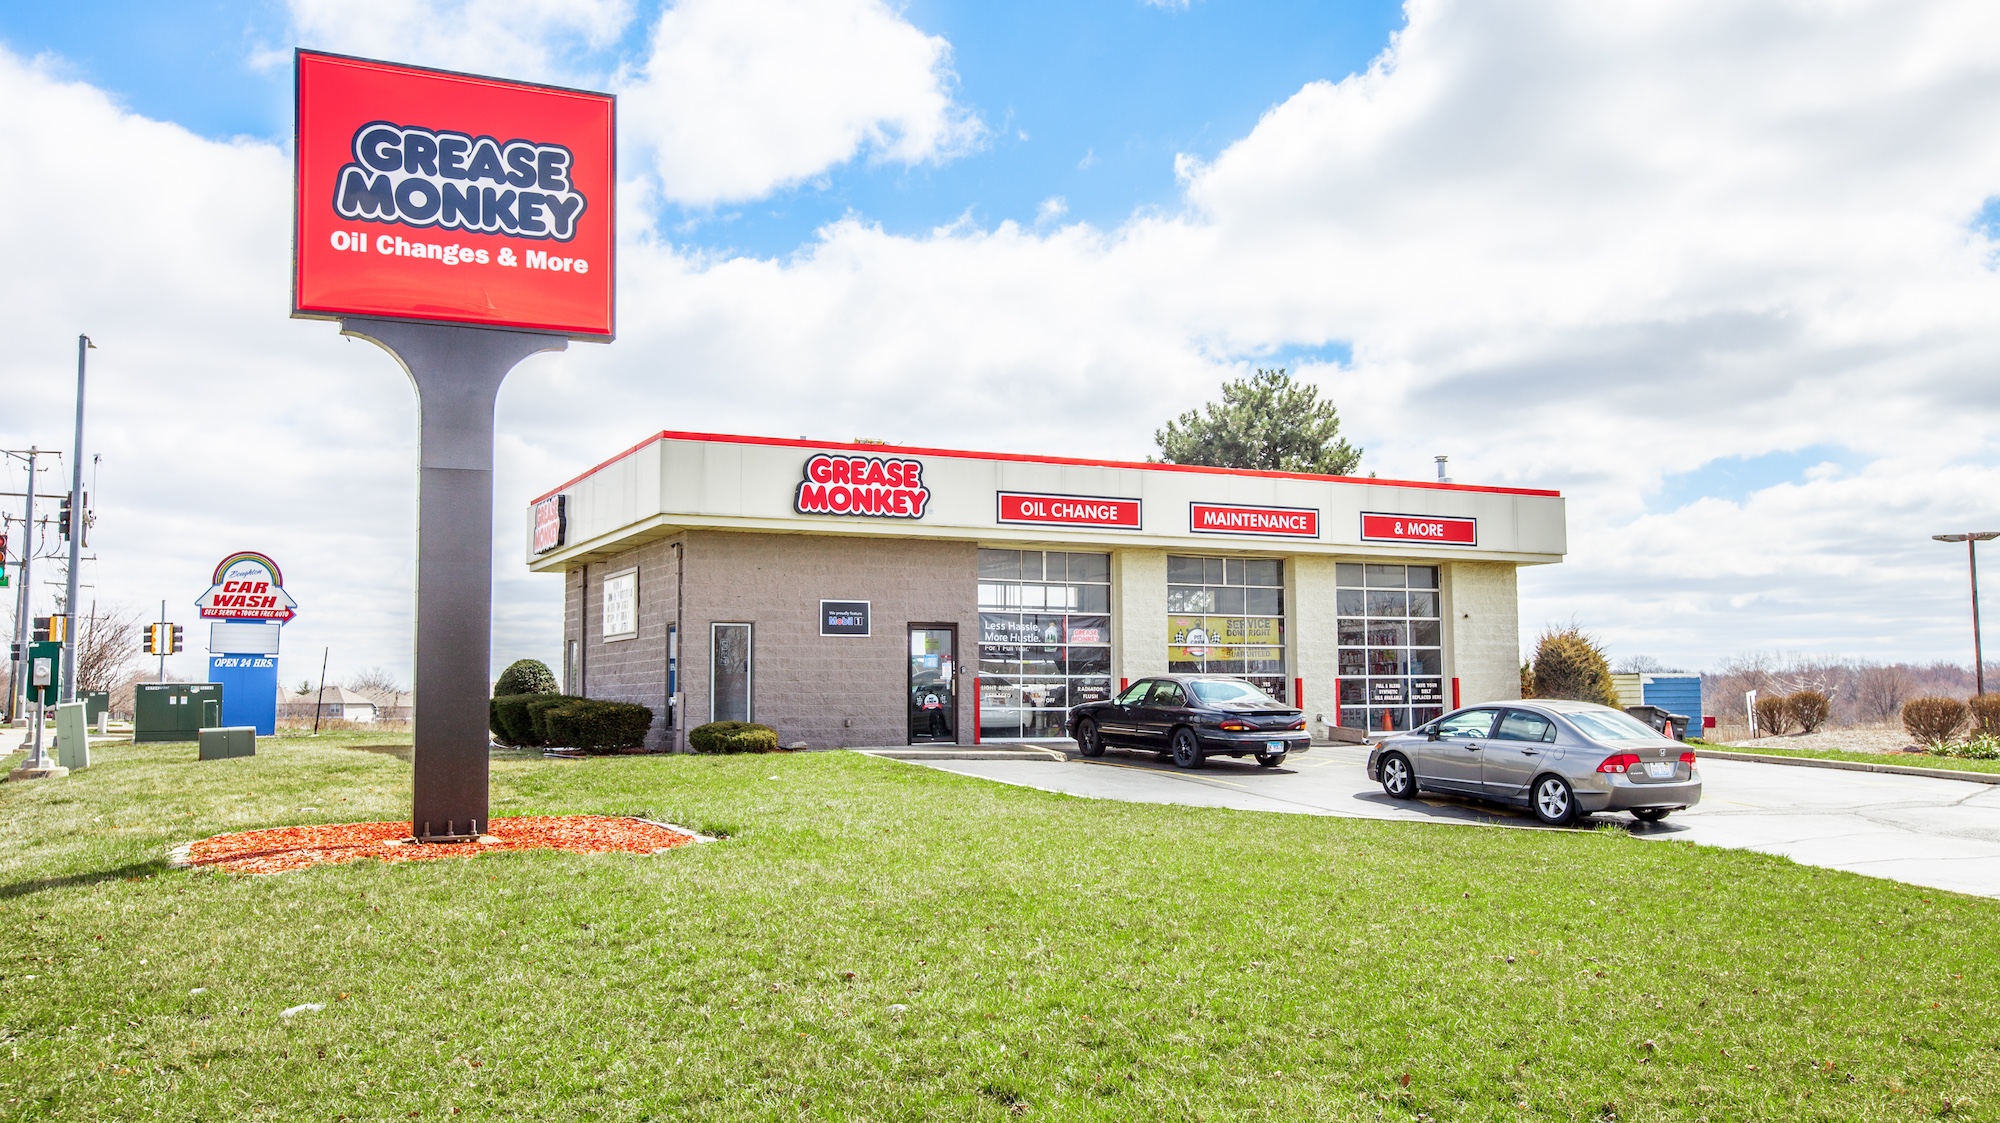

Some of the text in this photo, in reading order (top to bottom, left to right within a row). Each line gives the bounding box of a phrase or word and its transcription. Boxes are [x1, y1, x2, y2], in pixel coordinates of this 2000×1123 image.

[360, 128, 565, 192] GREASE
[342, 171, 579, 235] MONKEY
[330, 230, 589, 274] Oil Changes & More
[810, 458, 919, 488] GREASE
[800, 484, 926, 515] MONKEY
[1020, 501, 1118, 520] OIL CHANGE
[1203, 511, 1307, 530] MAINTENANCE
[1394, 523, 1444, 537] & MORE
[223, 581, 270, 594] CAR
[213, 595, 277, 608] WASH
[829, 616, 853, 625] Mobil
[984, 621, 1041, 633] Less Hassle,
[1226, 619, 1271, 629] SERVICE
[984, 632, 1041, 643] More Hustle.
[214, 658, 274, 668] OPEN 24 HRS.
